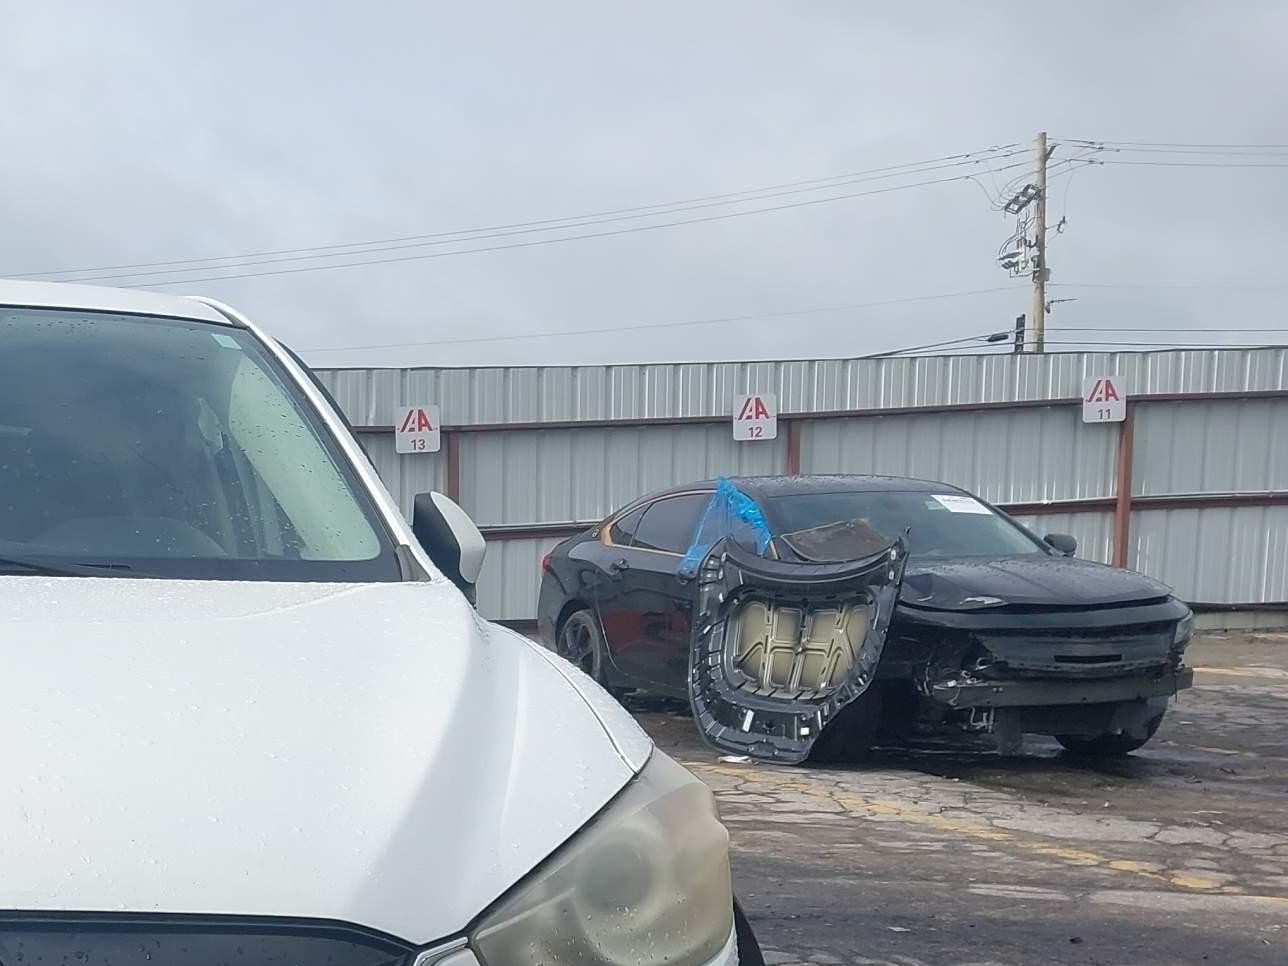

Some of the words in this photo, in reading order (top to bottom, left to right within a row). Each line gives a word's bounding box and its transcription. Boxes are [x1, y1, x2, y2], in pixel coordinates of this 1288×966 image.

[1097, 408, 1111, 420] 11
[748, 426, 763, 438] 12
[410, 438, 426, 451] 13
